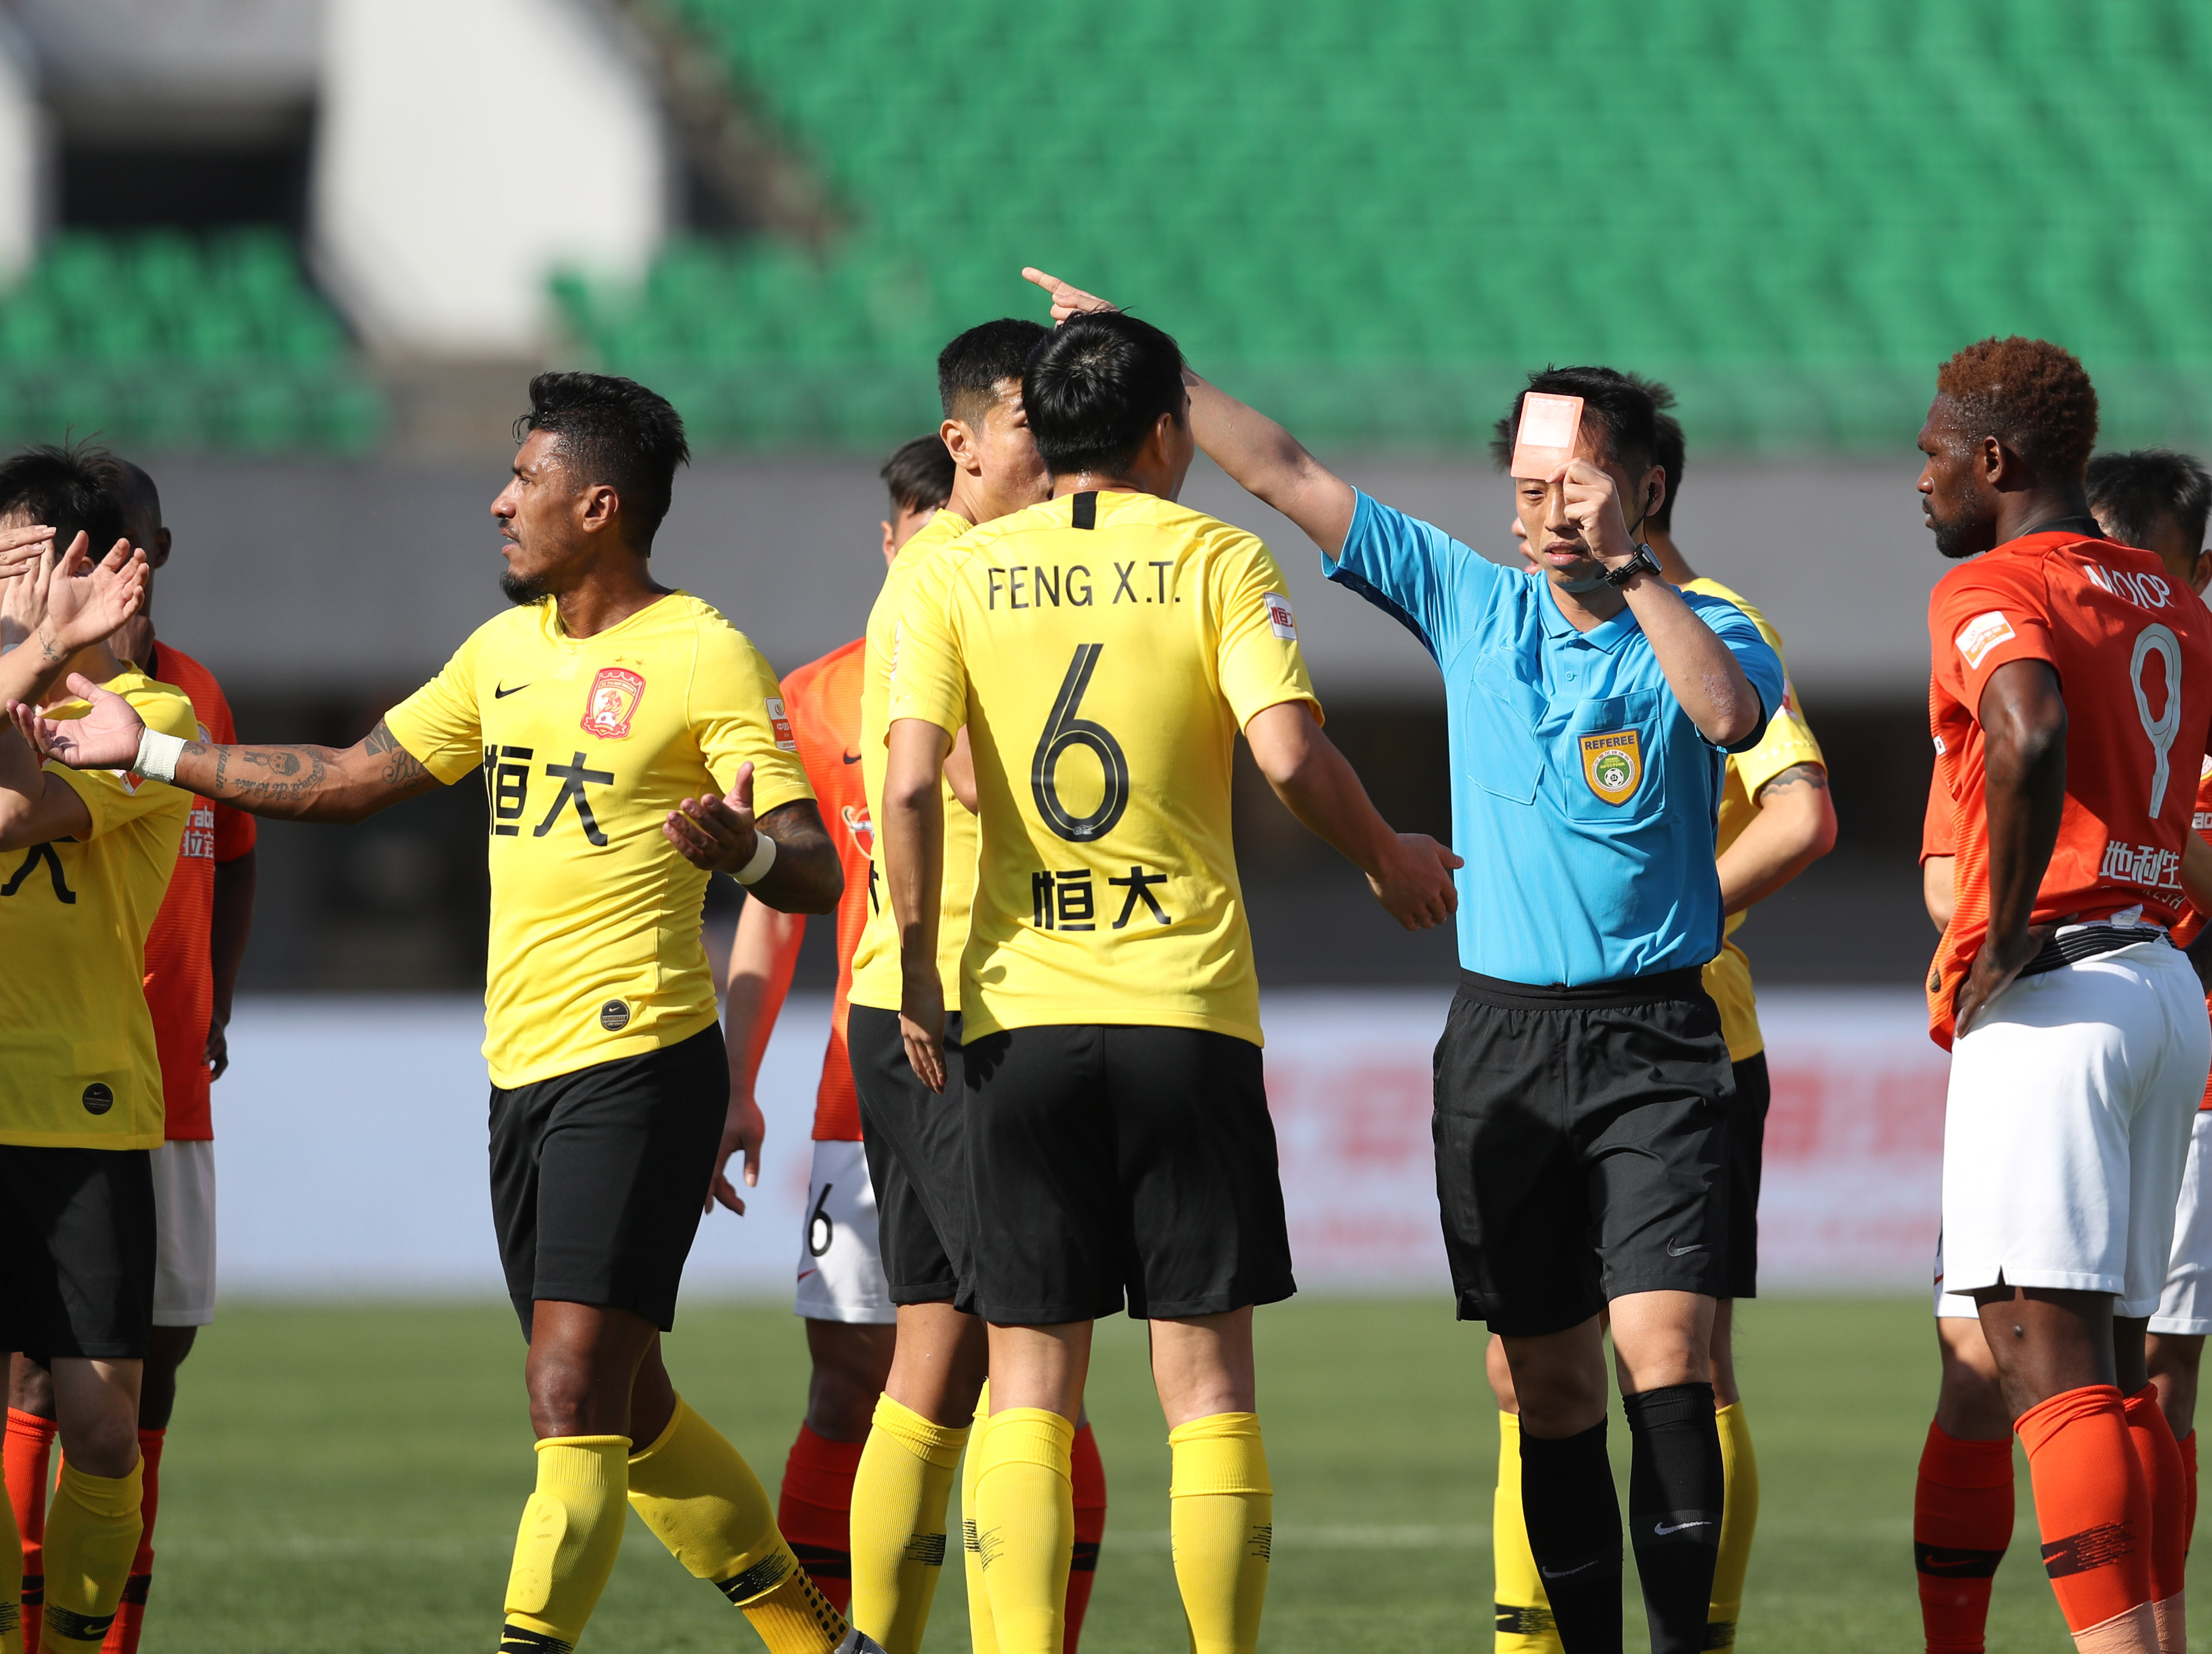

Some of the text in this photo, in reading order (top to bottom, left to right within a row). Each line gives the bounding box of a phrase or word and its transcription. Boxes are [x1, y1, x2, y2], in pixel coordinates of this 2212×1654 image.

[988, 561, 1180, 610] FENG X.T.
[1031, 643, 1129, 843] 6
[1585, 735, 1635, 750] REFEREE
[2130, 622, 2182, 818] 9
[484, 744, 615, 847] 恒大
[1032, 866, 1171, 931] 恒大
[809, 1183, 834, 1257] 6
